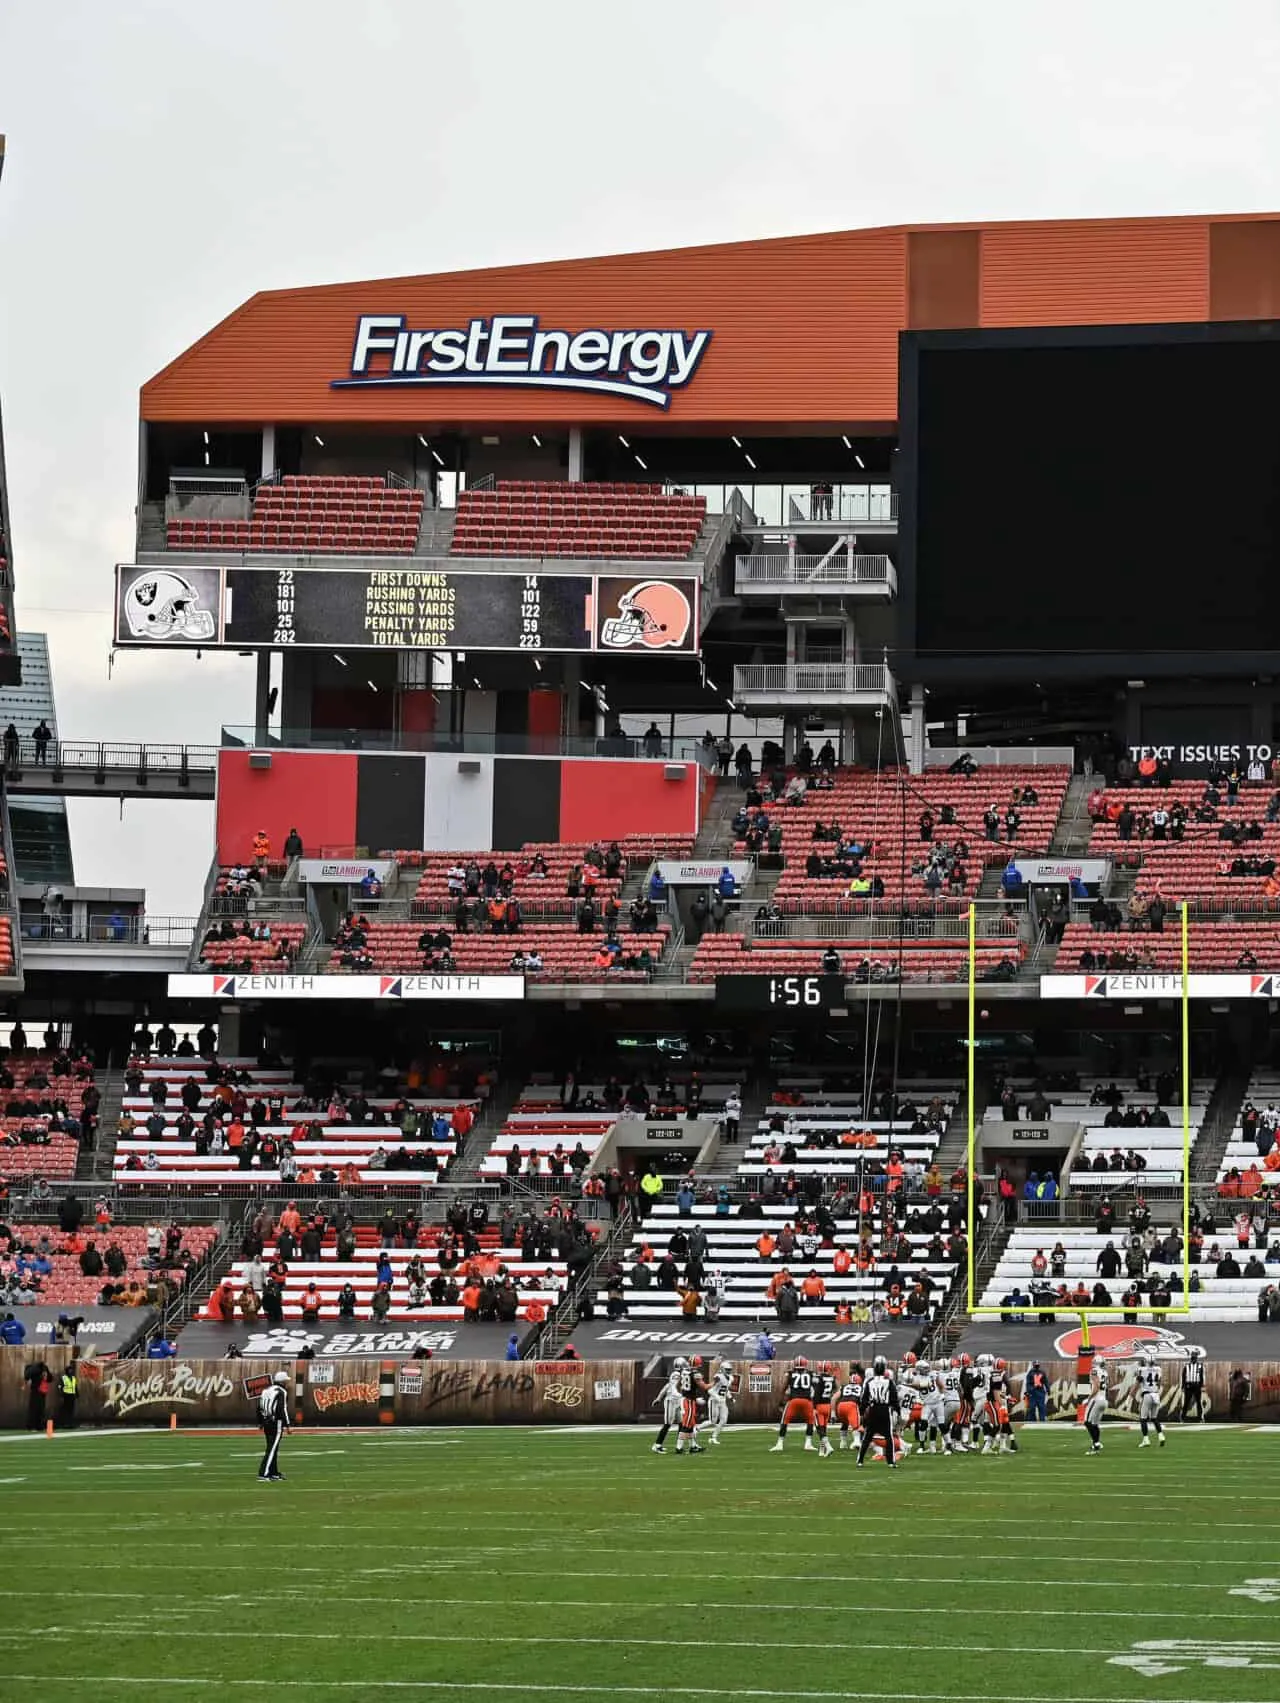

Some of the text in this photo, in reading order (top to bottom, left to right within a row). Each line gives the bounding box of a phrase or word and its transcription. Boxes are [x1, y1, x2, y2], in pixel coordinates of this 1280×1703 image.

[350, 314, 712, 386] FirstEnergy
[279, 571, 294, 584] 22
[371, 573, 447, 587] FIRST DOWNS
[525, 576, 538, 589] 14
[277, 584, 295, 598] 181
[366, 587, 456, 601] RUSHING YARDS
[522, 590, 540, 603] 101
[277, 599, 294, 613] 101
[366, 602, 455, 616] PASSING YARDS
[521, 605, 540, 617] 122
[278, 614, 292, 628] 25
[364, 616, 455, 631] PENALTY YARDS
[523, 620, 538, 633] 59
[273, 630, 296, 643] 282
[372, 631, 447, 646] TOTAL YARDS
[520, 634, 541, 648] 223
[1129, 746, 1175, 761] TEXT
[1180, 745, 1241, 762] ISSUES
[1246, 744, 1271, 760] TO
[238, 975, 313, 989] ZENITH
[404, 977, 480, 990] ZENITH
[1109, 975, 1185, 989] ZENITH
[770, 978, 820, 1005] 1:56
[328, 1330, 432, 1344] STAY
[595, 1329, 892, 1343] BRIDGESTONE
[102, 1370, 168, 1409] DAWG
[168, 1363, 234, 1401] POUND
[471, 1369, 535, 1398] LAND
[792, 1373, 811, 1389] 70
[823, 1382, 832, 1397] 2
[843, 1385, 861, 1397] 63
